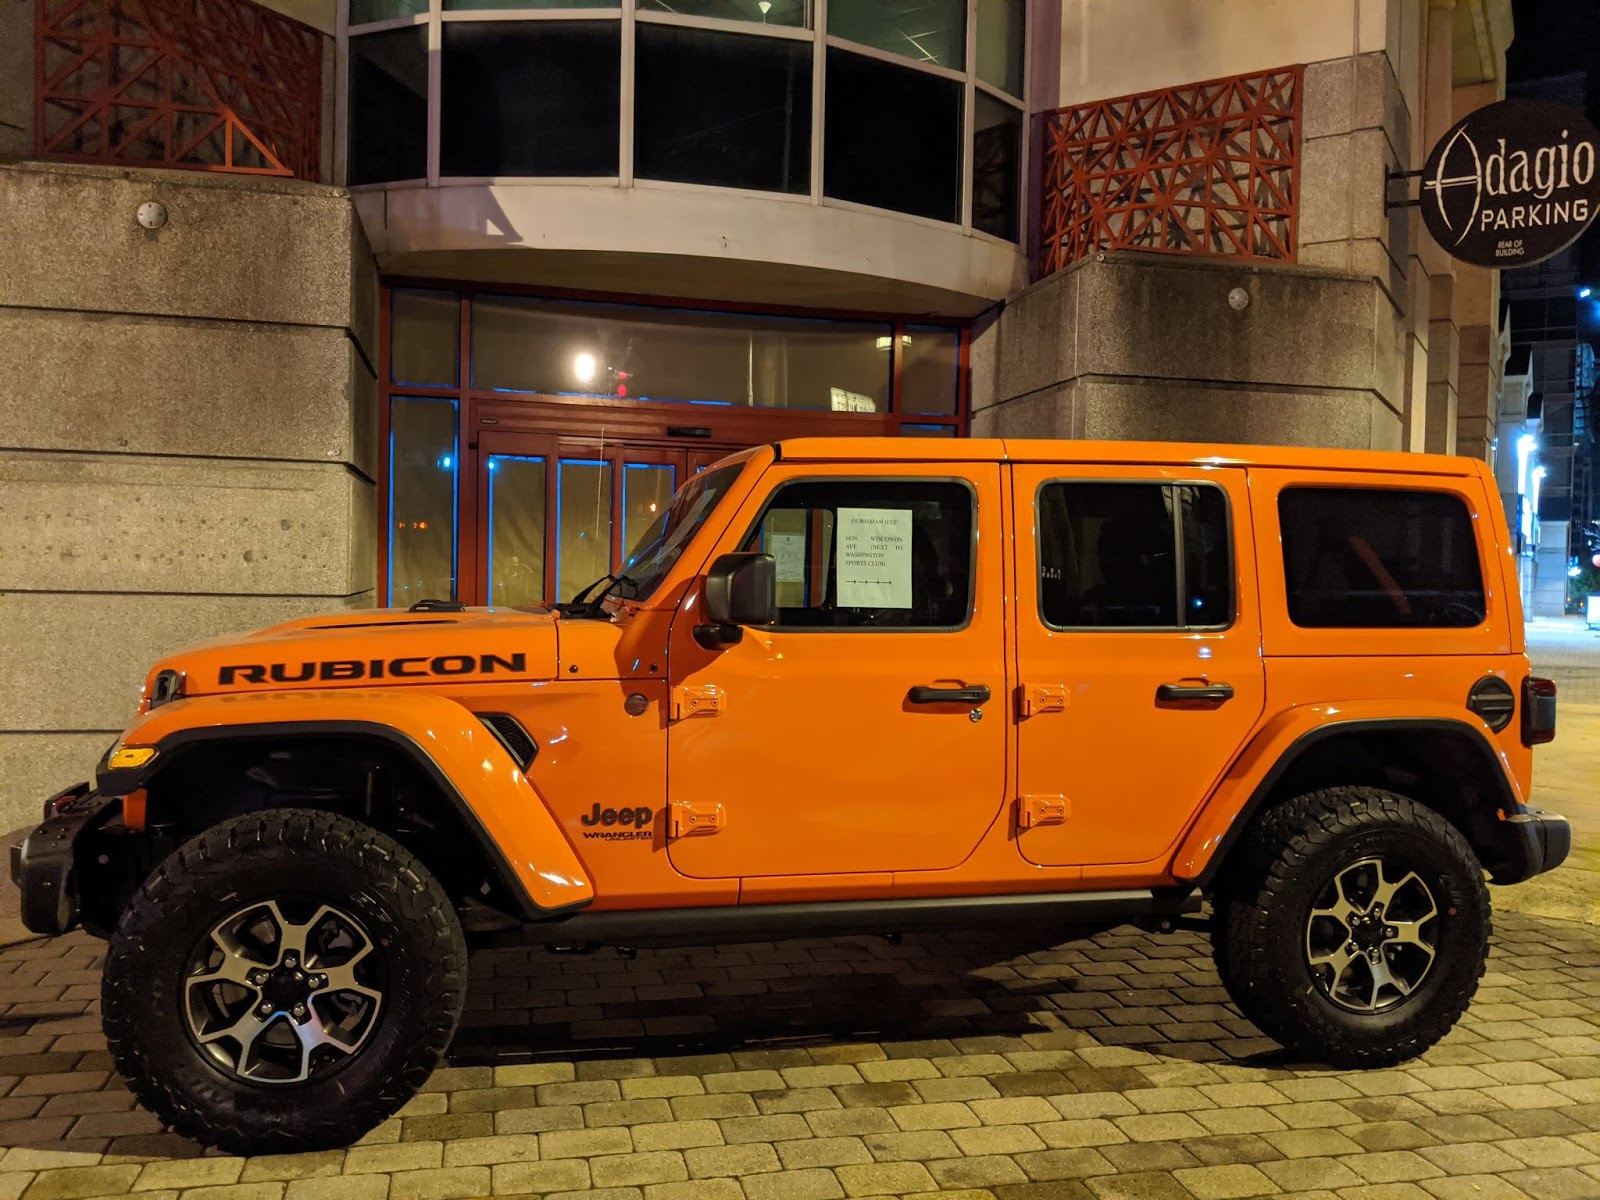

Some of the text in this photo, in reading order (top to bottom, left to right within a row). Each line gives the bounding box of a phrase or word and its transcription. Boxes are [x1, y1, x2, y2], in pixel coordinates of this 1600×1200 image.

[1424, 123, 1595, 247] Adagio
[1480, 199, 1589, 232] PARKING
[1495, 247, 1525, 257] BUILDING
[1497, 239, 1523, 249] REAR OF
[218, 652, 526, 686] RUBICON
[581, 802, 653, 829] Jeep
[583, 831, 652, 839] WRANGLER
